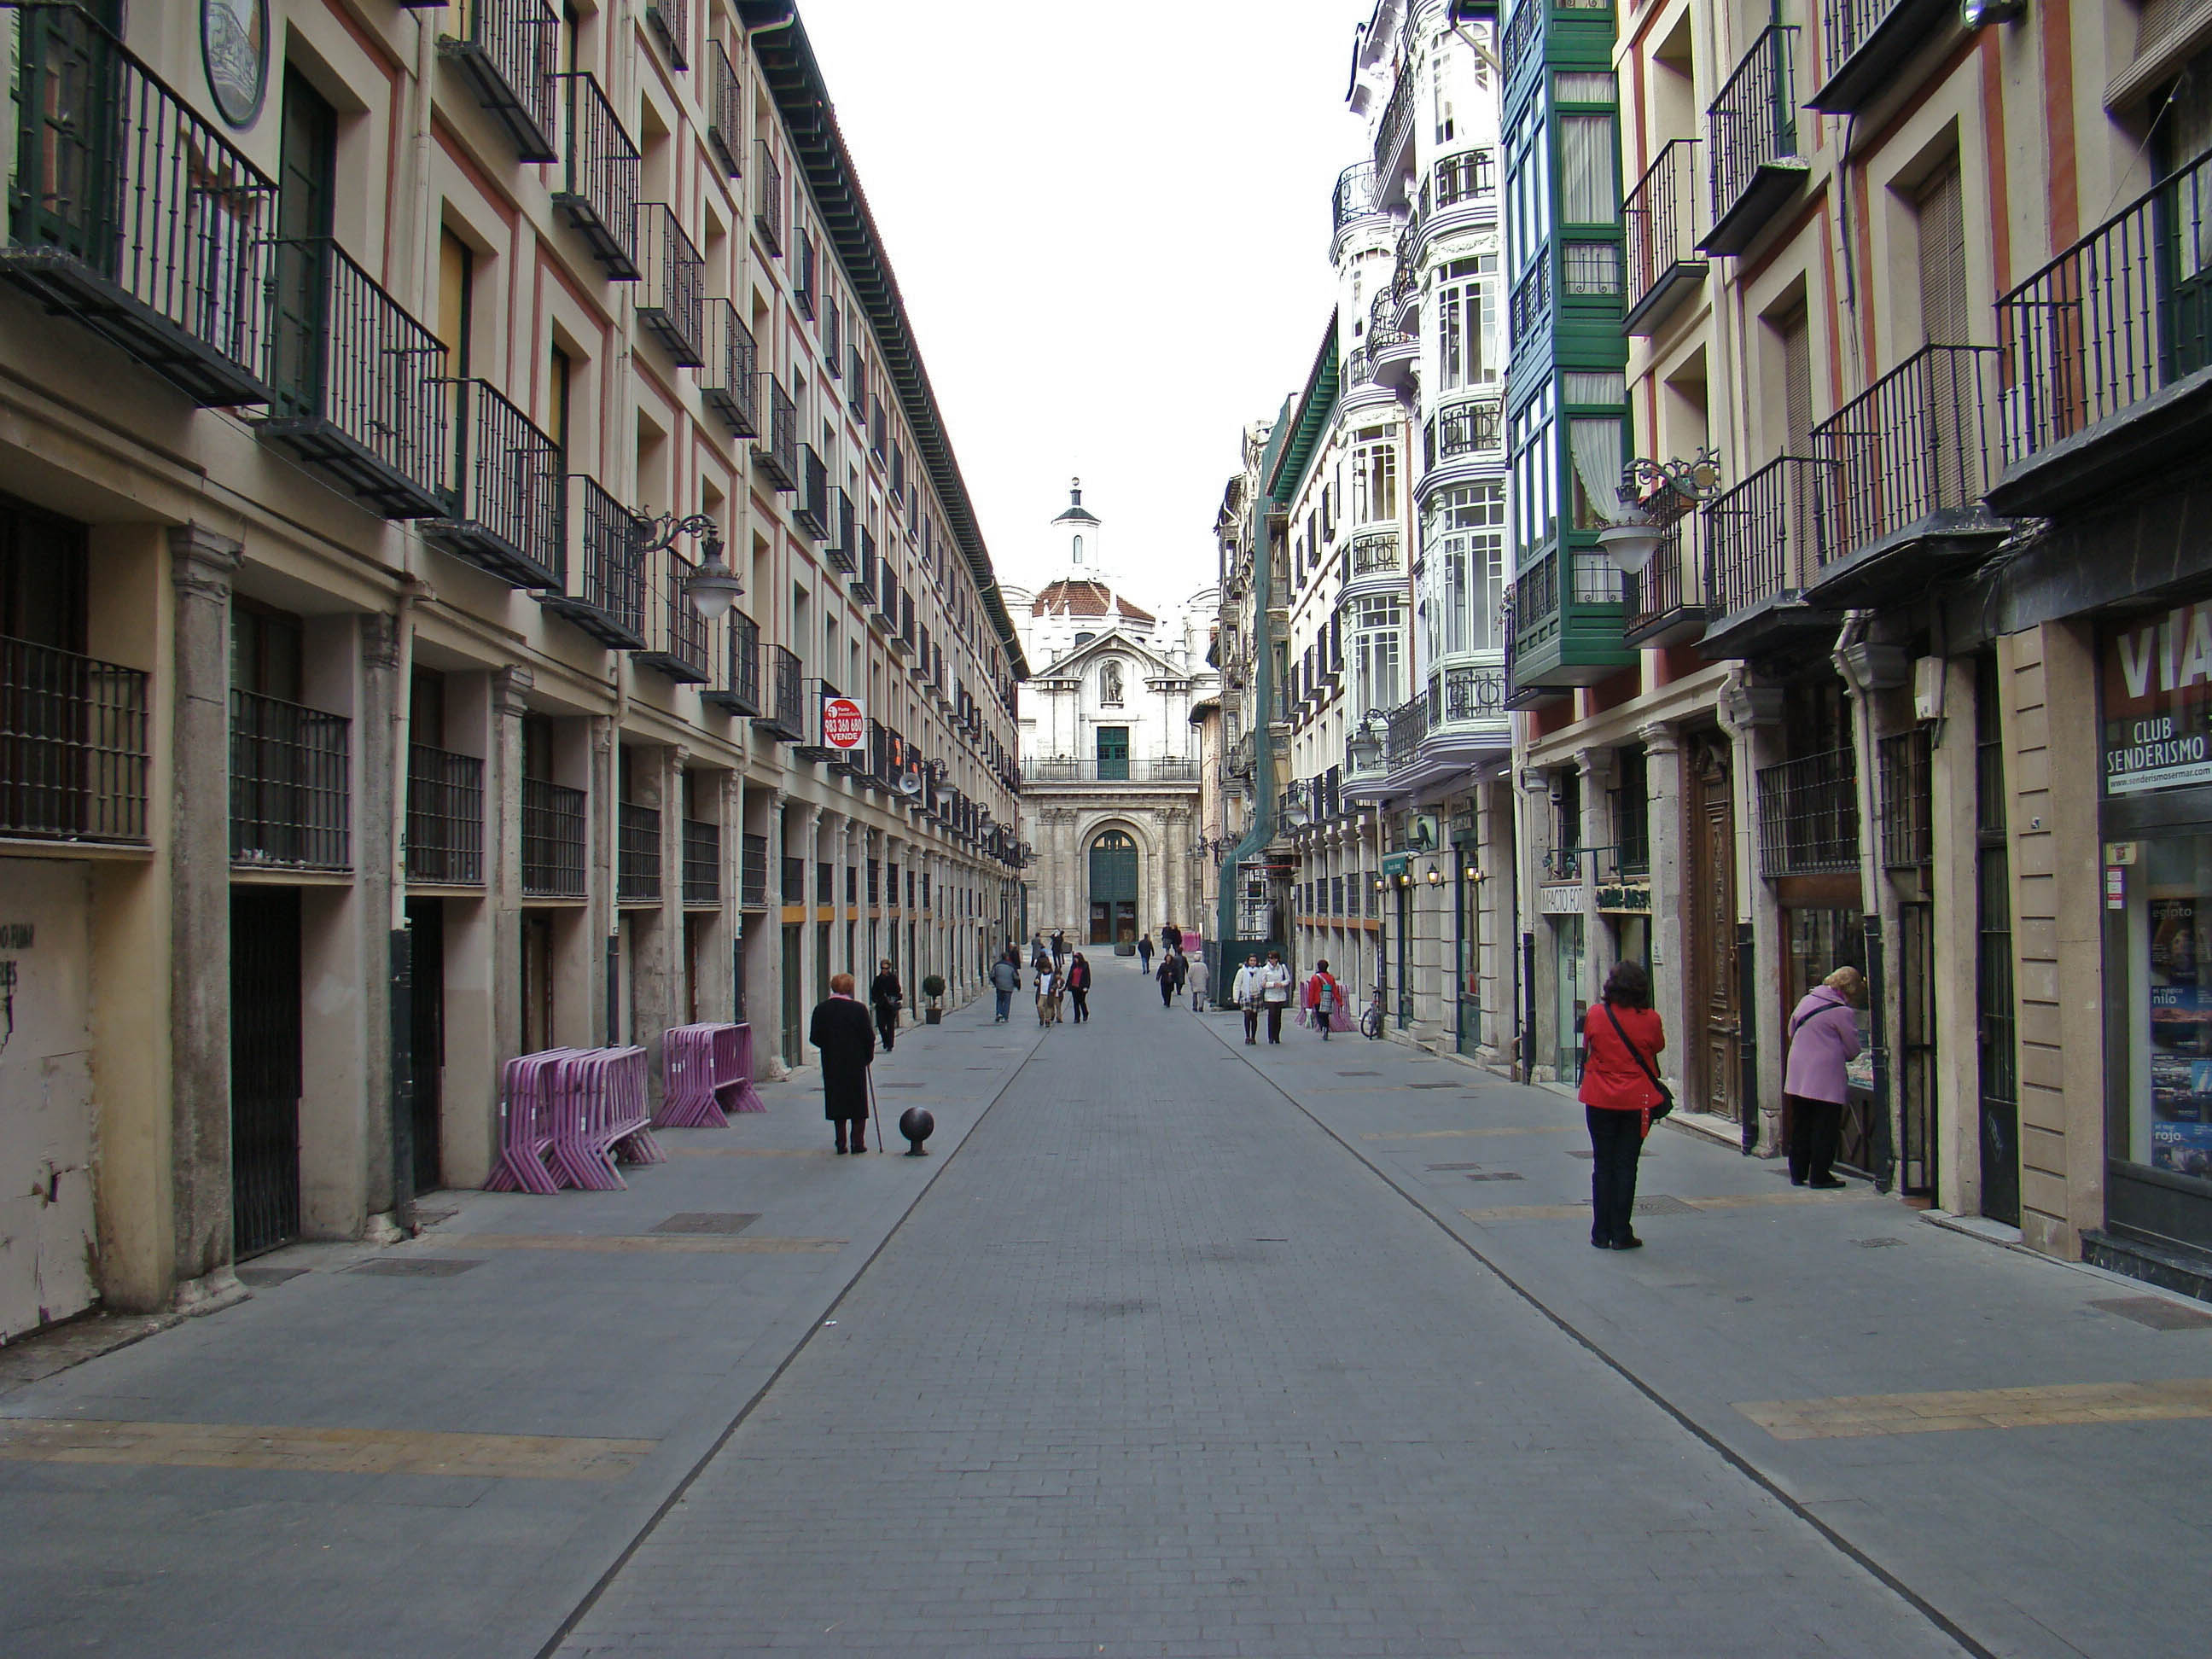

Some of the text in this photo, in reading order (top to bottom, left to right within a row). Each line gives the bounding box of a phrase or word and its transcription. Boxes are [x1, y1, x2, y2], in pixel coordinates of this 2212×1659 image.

[831, 732, 859, 741] VENDE
[2133, 717, 2172, 744] CLUB
[2107, 736, 2204, 773] SENDERISMO
[2110, 767, 2211, 788] www.senderismosermar.com
[2153, 992, 2178, 1004] nilo
[2155, 1128, 2182, 1144] rojo
